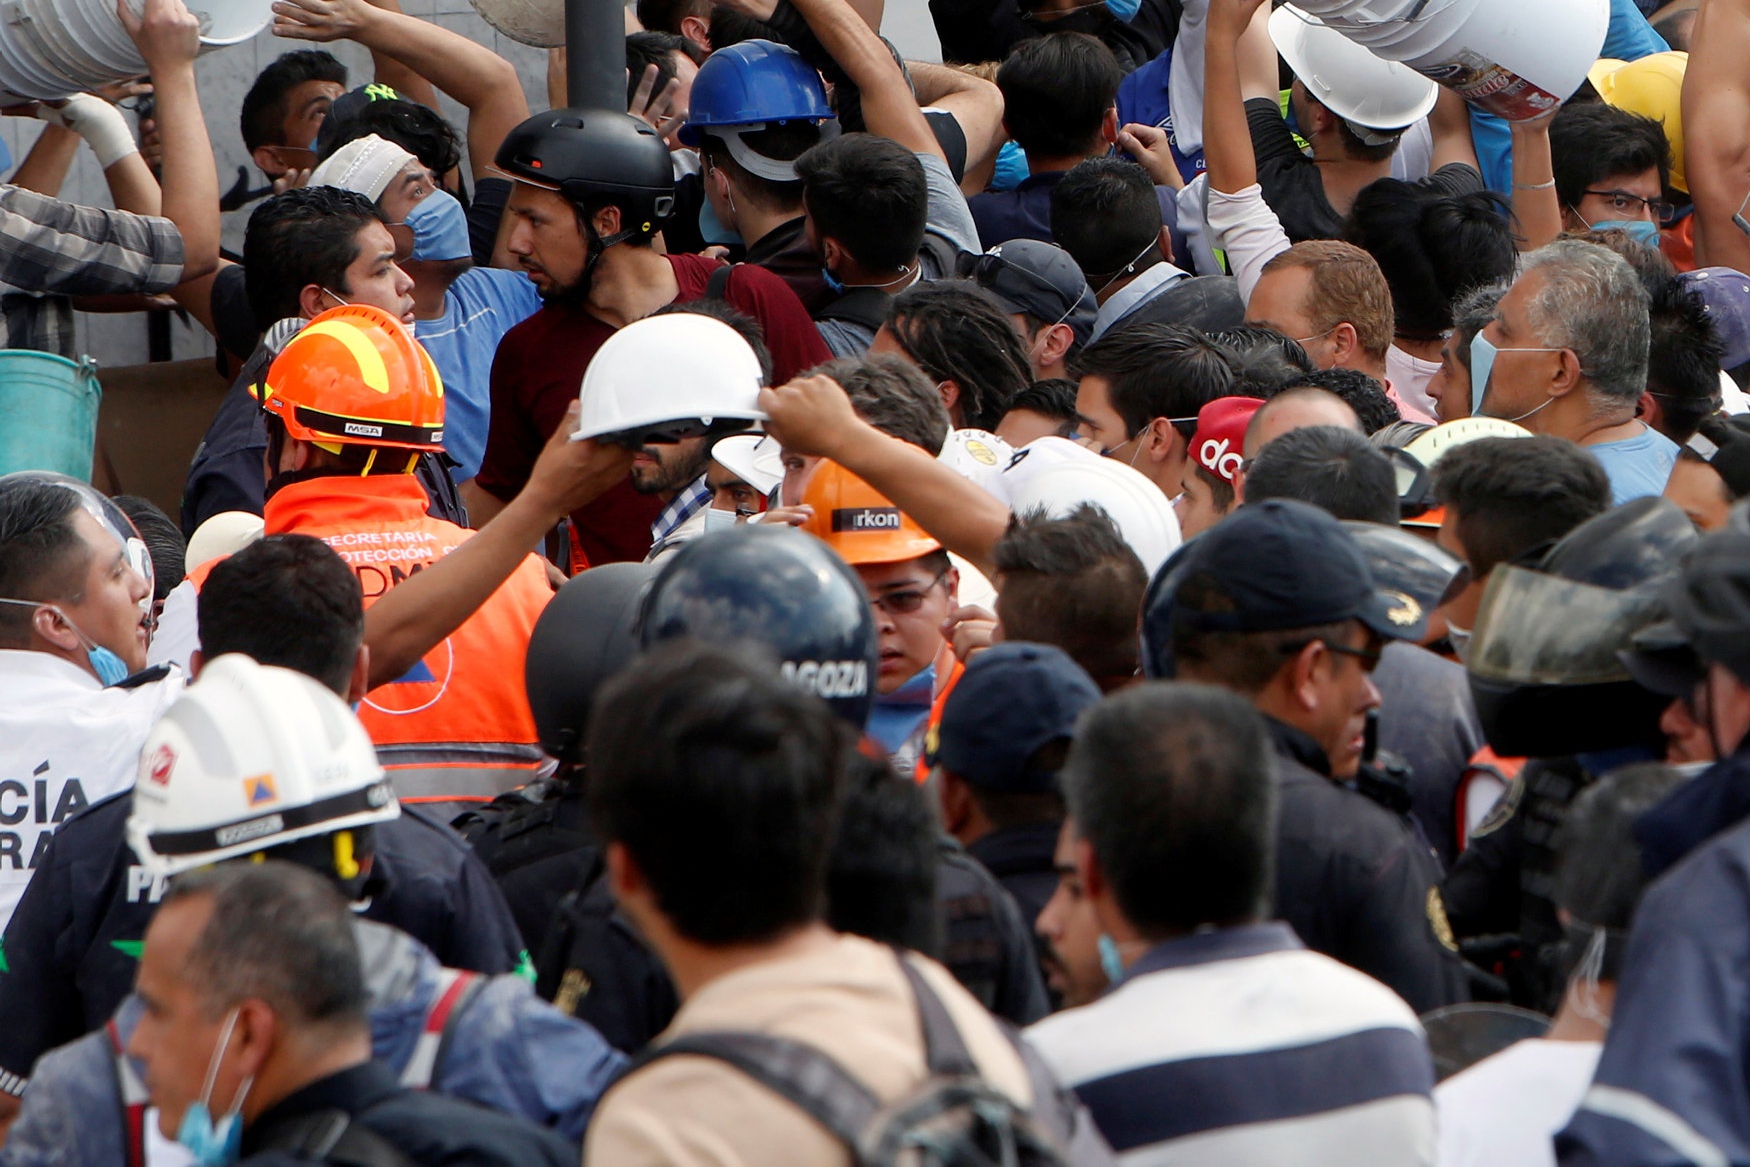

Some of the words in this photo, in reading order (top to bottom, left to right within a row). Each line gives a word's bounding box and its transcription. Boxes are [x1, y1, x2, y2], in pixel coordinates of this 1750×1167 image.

[347, 424, 381, 435] MSA
[853, 509, 899, 527] rkon
[322, 531, 438, 547] SECRETARÍA
[338, 544, 433, 563] OTECCIÓN
